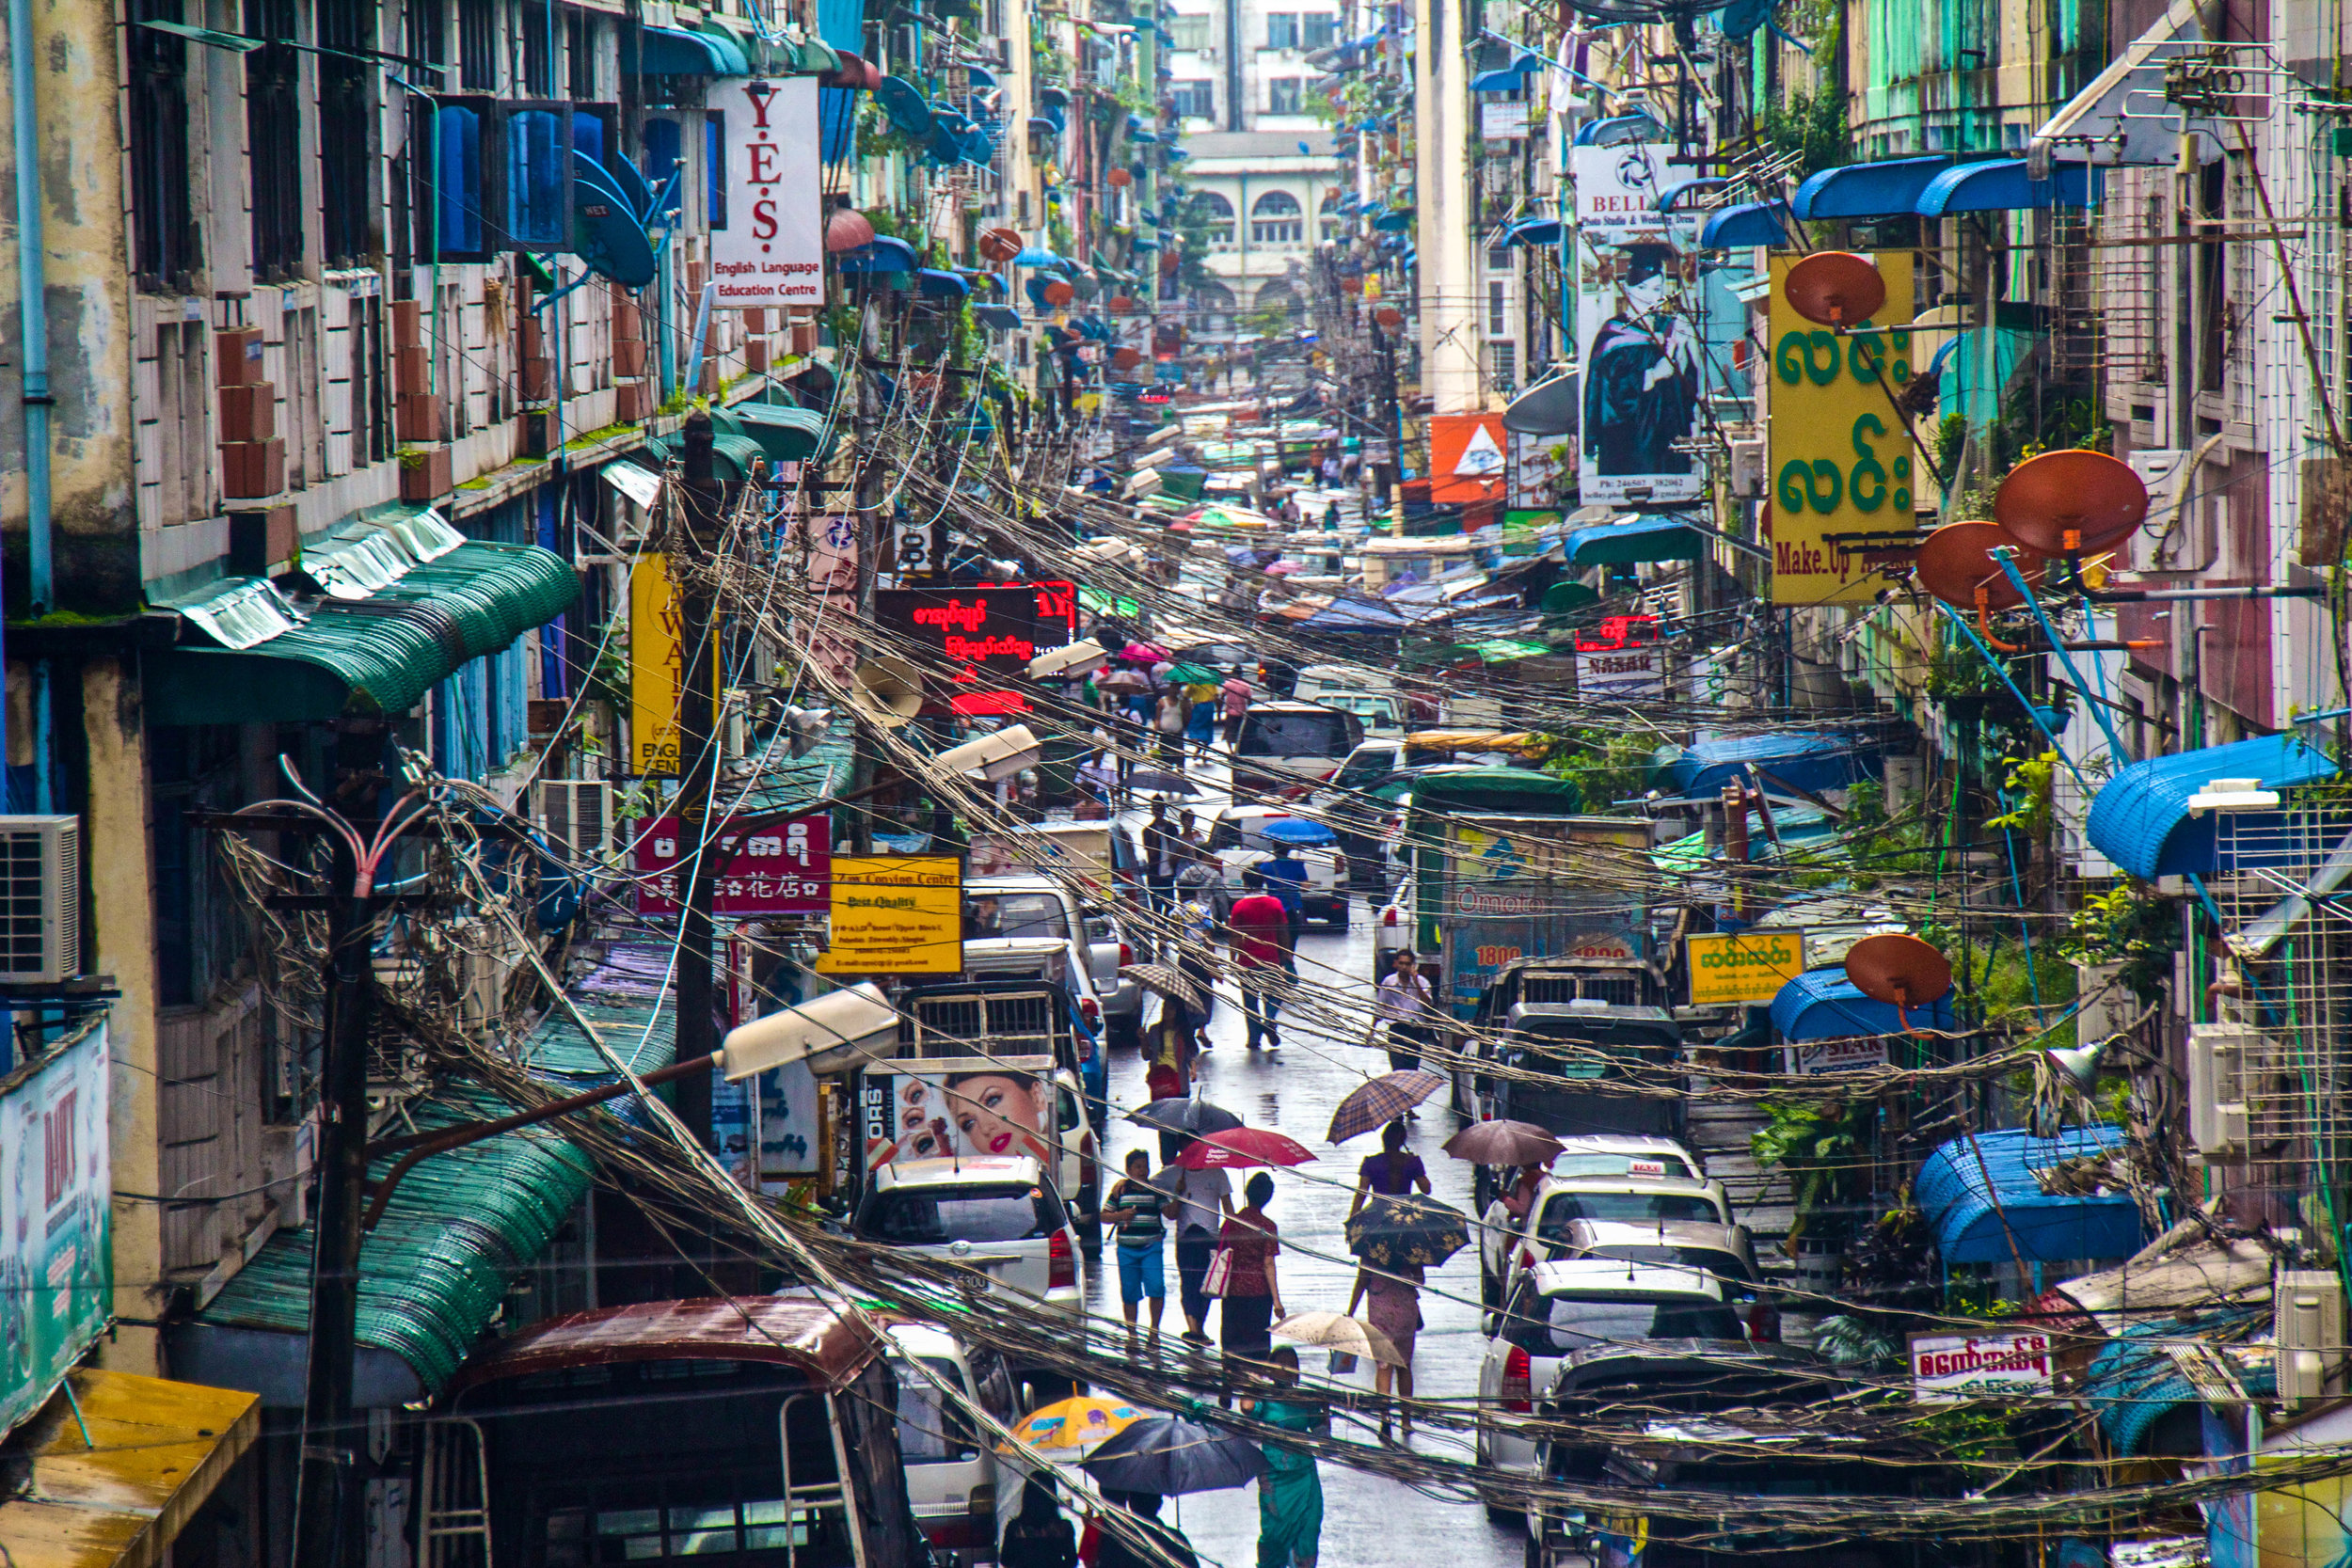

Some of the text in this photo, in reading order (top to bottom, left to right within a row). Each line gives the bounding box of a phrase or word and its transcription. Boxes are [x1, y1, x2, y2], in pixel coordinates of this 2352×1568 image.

[1592, 195, 1684, 212] BELLY
[1603, 214, 1627, 226] Studio
[715, 261, 819, 276] English Language
[719, 283, 817, 296] Education Centre
[643, 742, 681, 758] ENGL
[917, 874, 955, 885] Centre
[874, 895, 916, 909] Quality
[1632, 1164, 1661, 1172] TAXI
